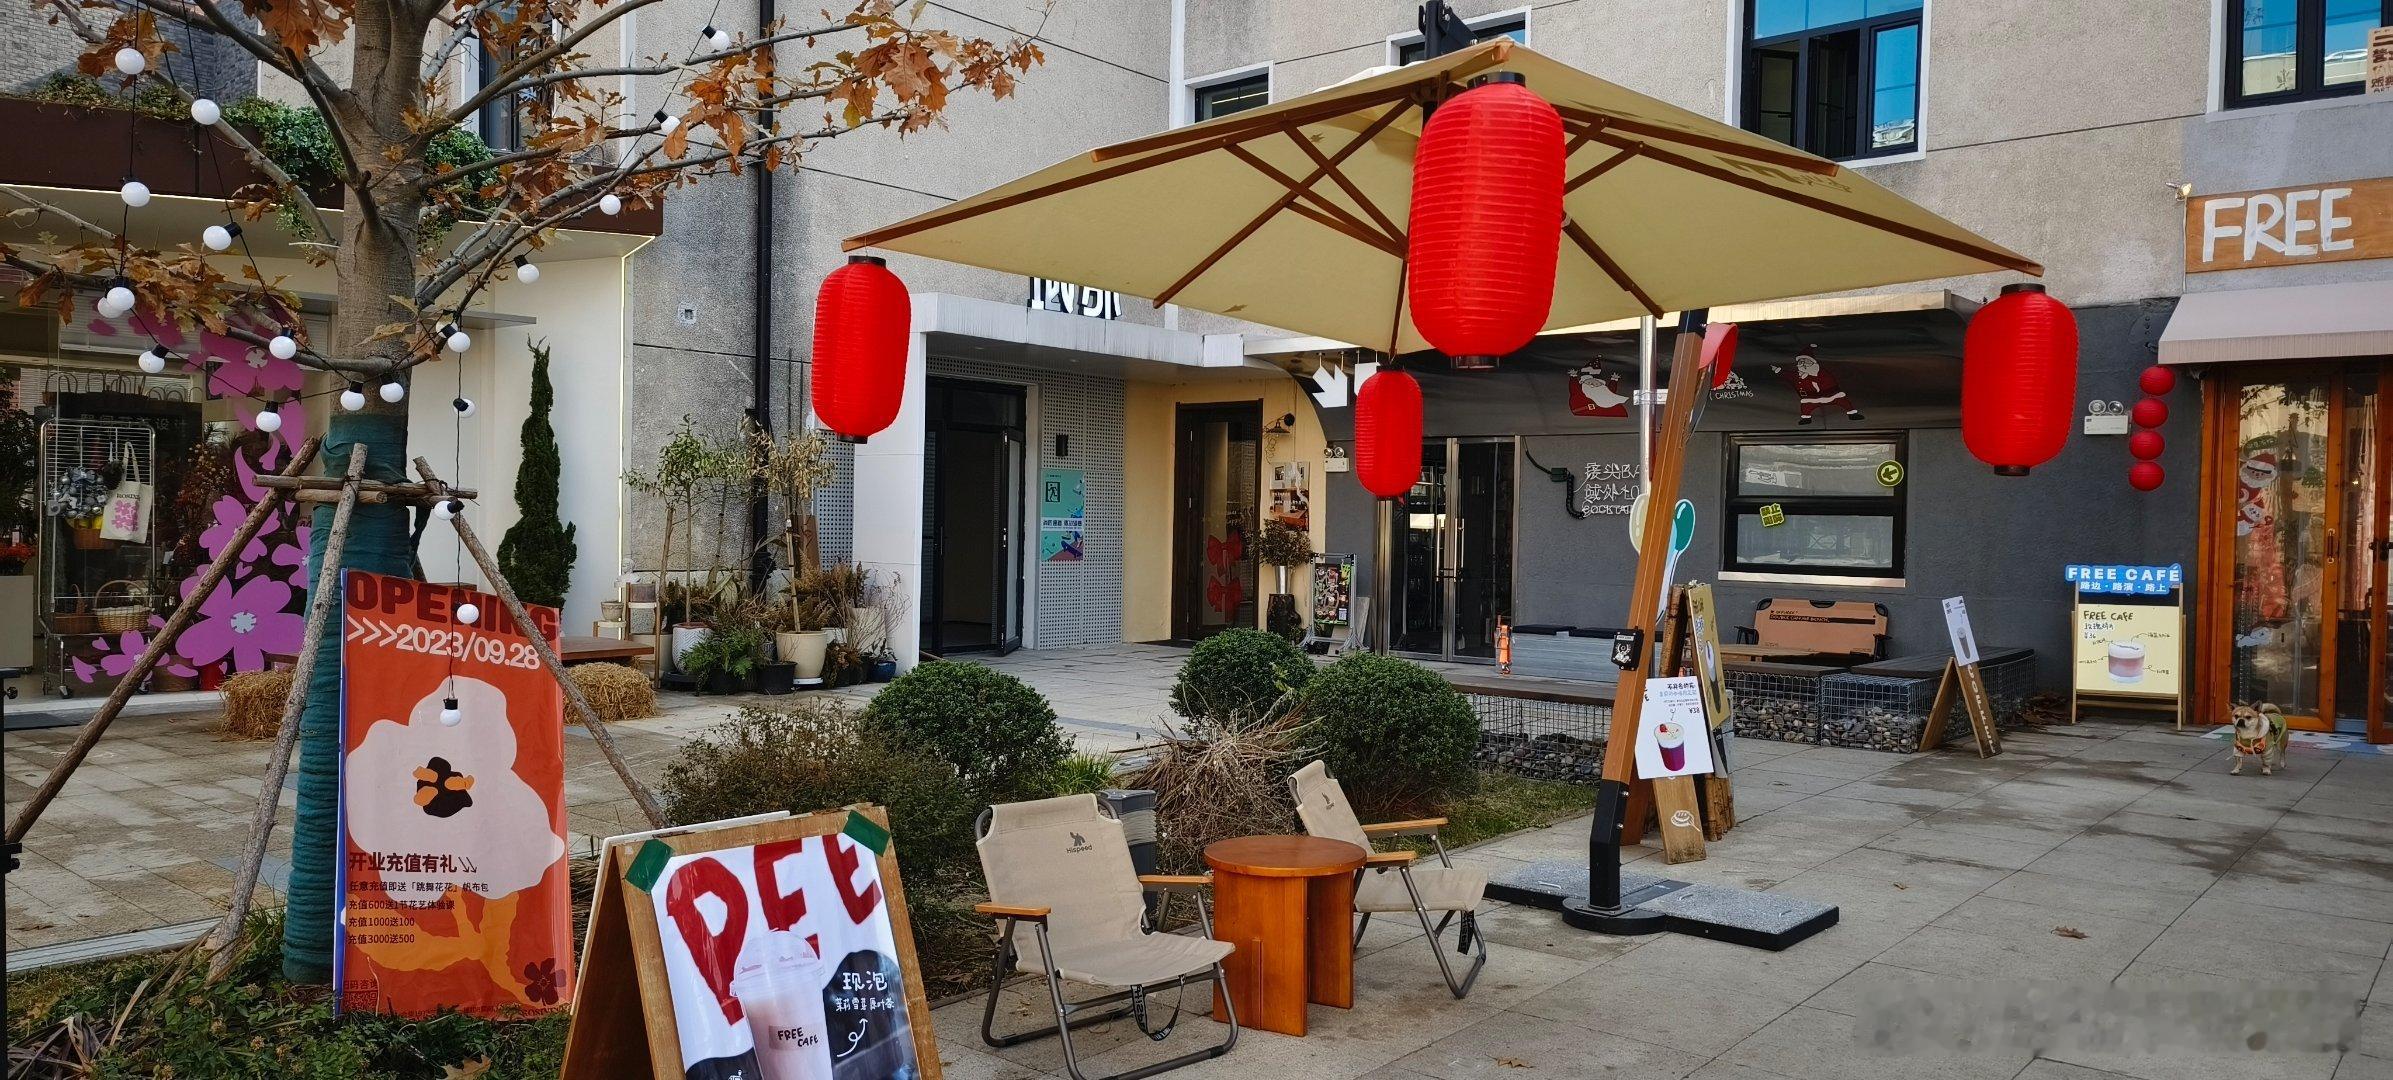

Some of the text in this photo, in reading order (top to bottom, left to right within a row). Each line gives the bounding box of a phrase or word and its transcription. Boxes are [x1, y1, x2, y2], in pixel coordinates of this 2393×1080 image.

[2202, 188, 2355, 263] FREE
[1715, 390, 1754, 400] CHRISTMAS
[2068, 565, 2180, 582] FREE CAFÉ
[346, 571, 557, 642] OPENING
[2083, 610, 2134, 622] FREE CAFE
[396, 623, 542, 670] 2023/09.28
[1066, 844, 1093, 855] Hispeed
[349, 851, 458, 874] 开业充值有礼
[349, 880, 490, 894] 任意充值即送「跳舞花花」帆布包
[348, 899, 456, 911] 充值600送1节花艺体验课
[348, 917, 416, 927] 充值1000送100
[347, 933, 416, 944] 充值3000送500
[842, 970, 888, 992] 现泡
[777, 1027, 804, 1041] FREE
[797, 1035, 819, 1048] CAFE
